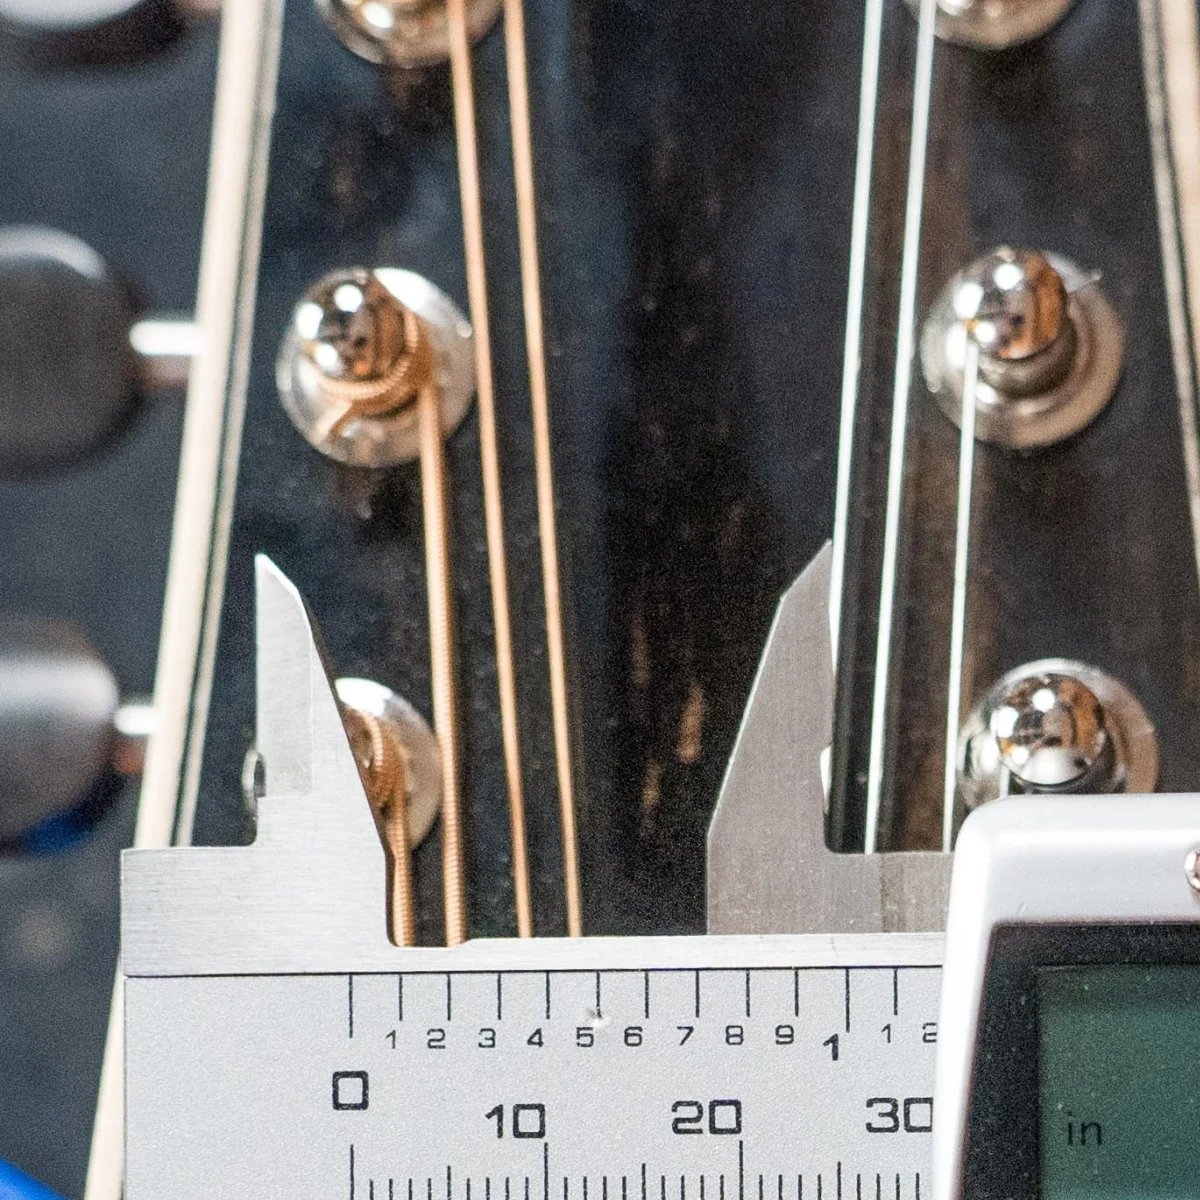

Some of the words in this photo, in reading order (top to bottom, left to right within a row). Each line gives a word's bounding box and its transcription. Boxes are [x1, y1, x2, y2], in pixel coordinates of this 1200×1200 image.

[385, 1029, 397, 1049] 1
[426, 1028, 446, 1049] 2
[478, 1028, 496, 1048] 3
[526, 1028, 544, 1048] 4
[576, 1026, 595, 1048] 5
[624, 1026, 643, 1047] 6
[677, 1026, 694, 1046] 7
[725, 1025, 744, 1046] 8
[775, 1024, 795, 1046] 9
[823, 1033, 839, 1061] 1
[881, 1023, 891, 1043] 1
[332, 1070, 369, 1111] 0
[485, 1103, 546, 1139] 10
[671, 1099, 742, 1135] 20
[865, 1097, 934, 1133] 30
[1067, 1112, 1102, 1147] in
